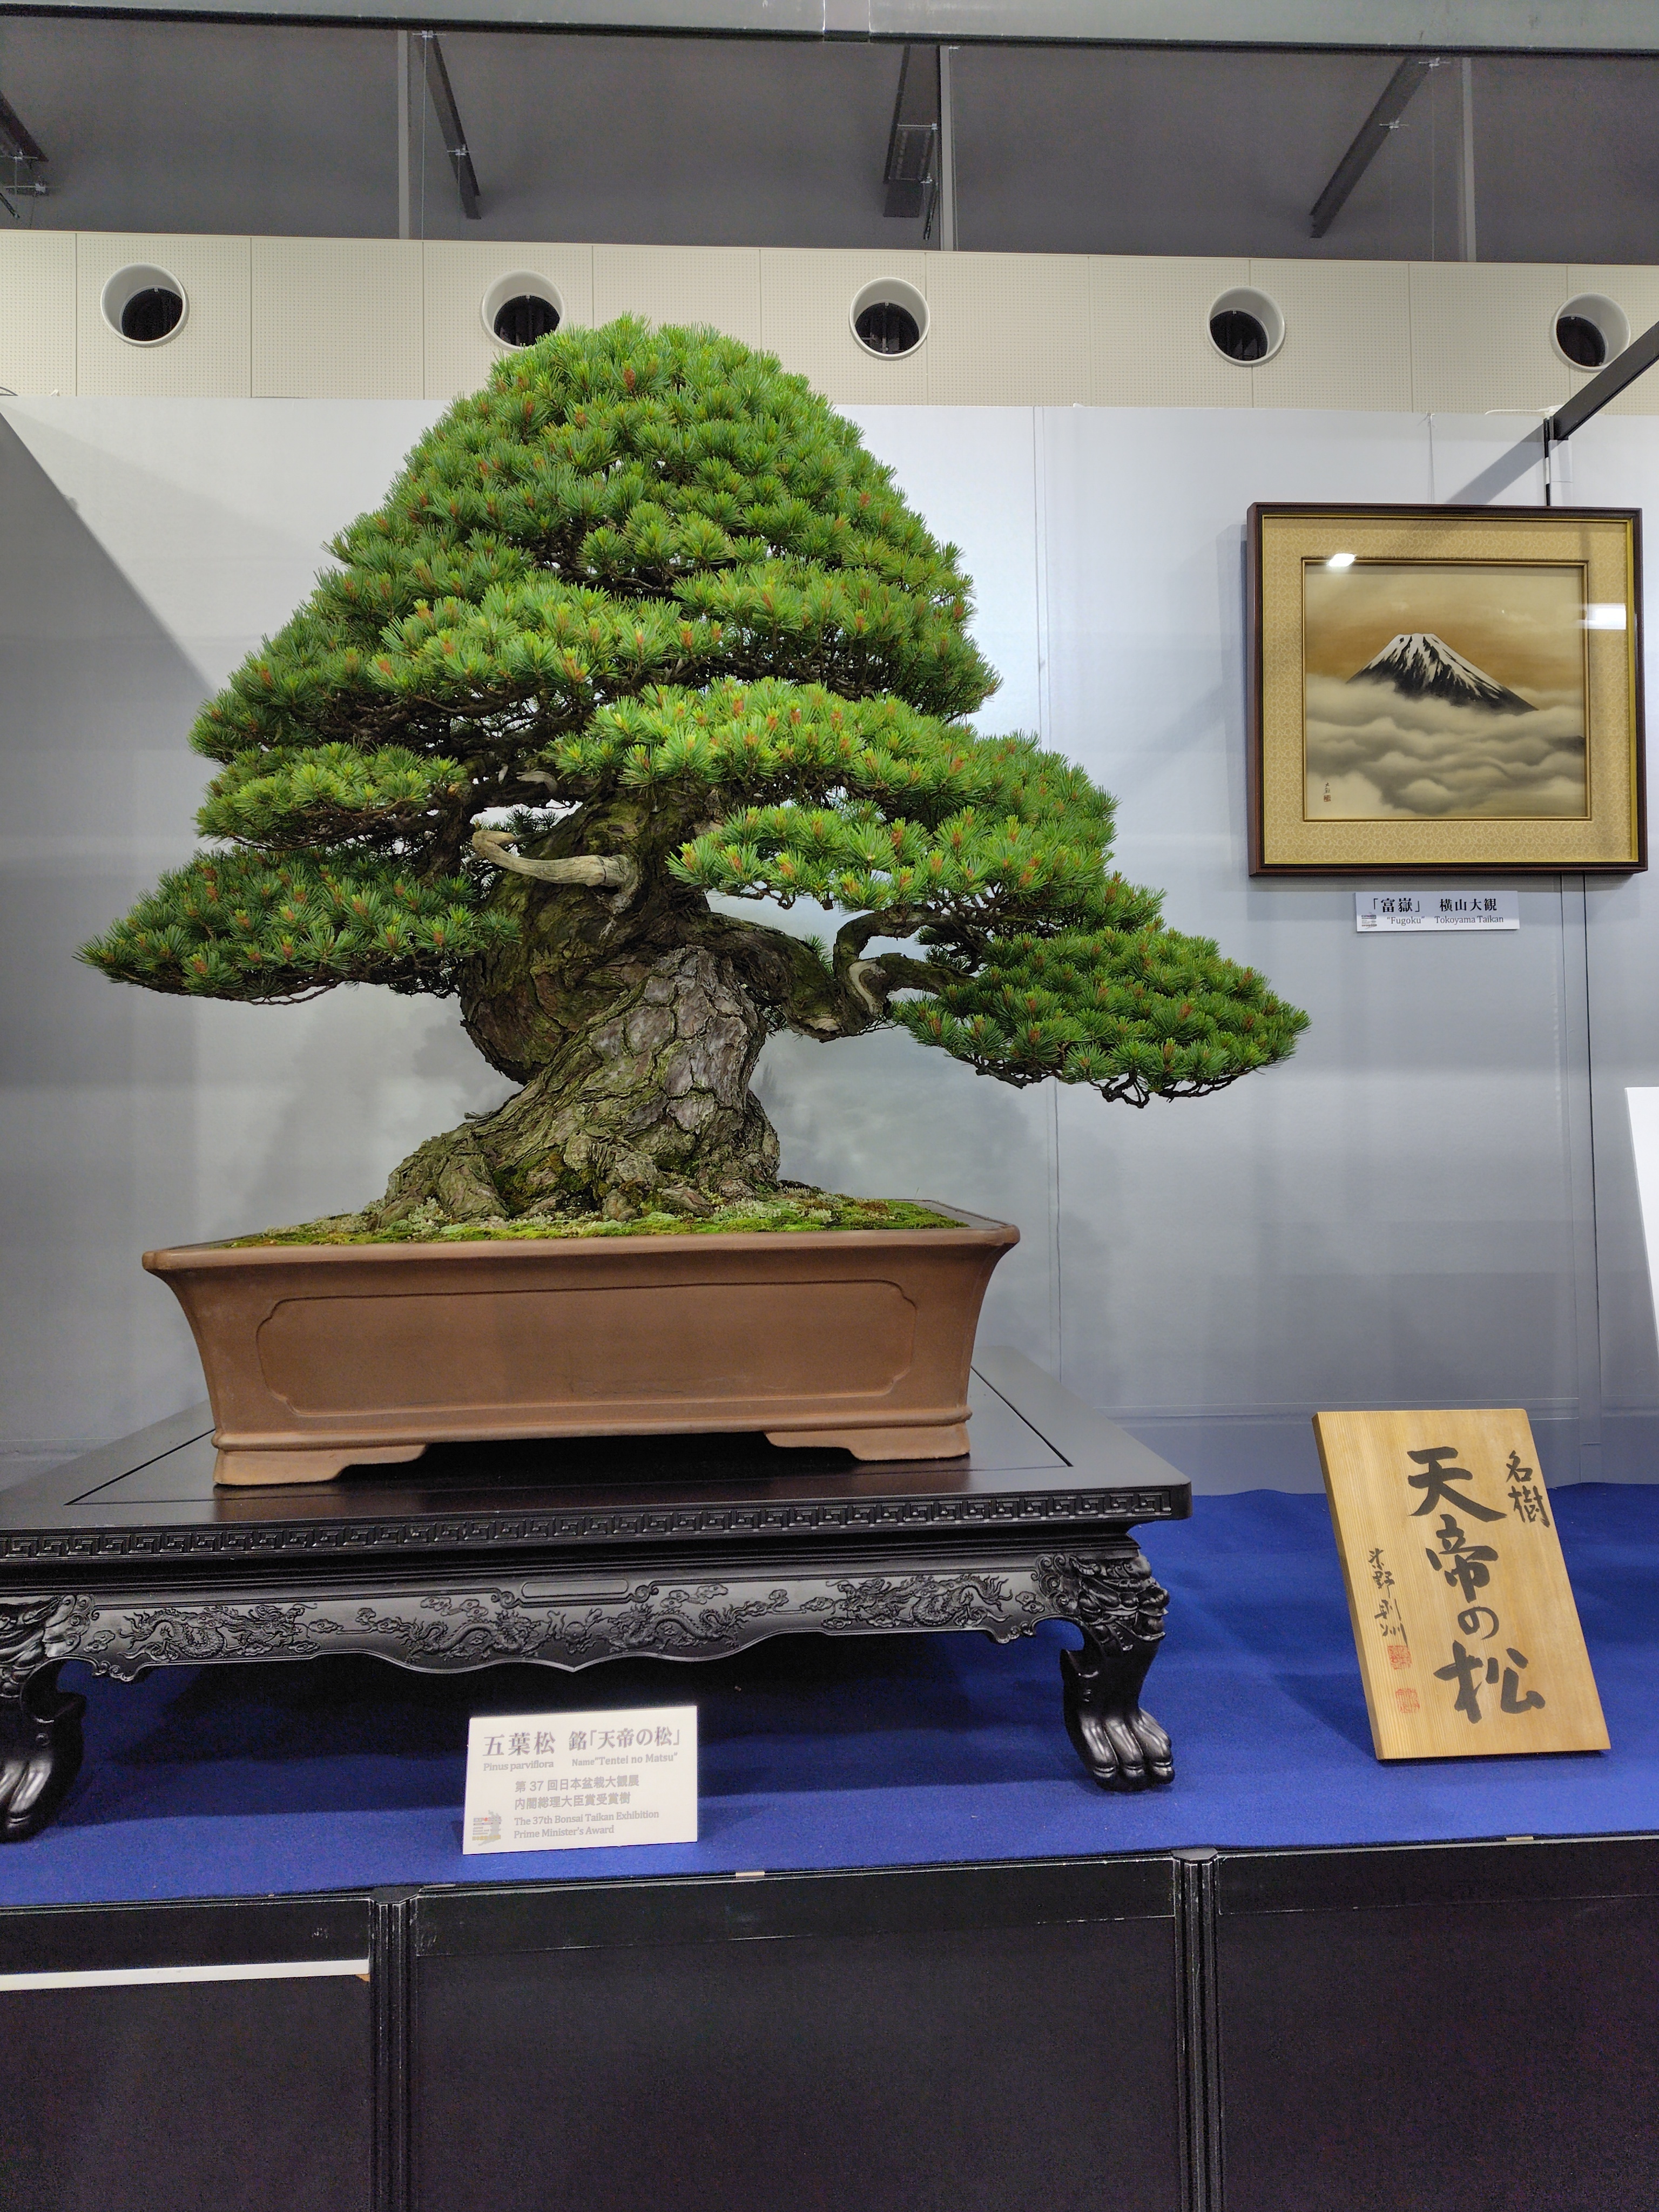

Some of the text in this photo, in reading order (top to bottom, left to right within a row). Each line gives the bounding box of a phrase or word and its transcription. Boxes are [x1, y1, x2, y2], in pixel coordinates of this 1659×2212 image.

[1373, 898, 1497, 913] 「富嶽」 横山大観
[1387, 916, 1425, 926] “Fugoku”
[1434, 915, 1475, 925] Tokoyama
[1477, 915, 1503, 923] Taikan
[1506, 1449, 1550, 1528] 名樹
[1407, 1446, 1546, 1724] 天帝の松
[482, 1726, 680, 1756] 五葉松 銘「天帝の松」
[483, 1762, 509, 1771] Pinus
[510, 1760, 554, 1771] parviflora
[645, 1752, 678, 1763] Matsu”
[515, 1781, 527, 1793] 第
[529, 1781, 544, 1791] 37
[515, 1791, 631, 1810] 内閣総理大臣賞受賞樹
[515, 1810, 659, 1826] The 37th Bonsai Taikan Exhibition
[514, 1825, 615, 1839] Prime Minister's Award
